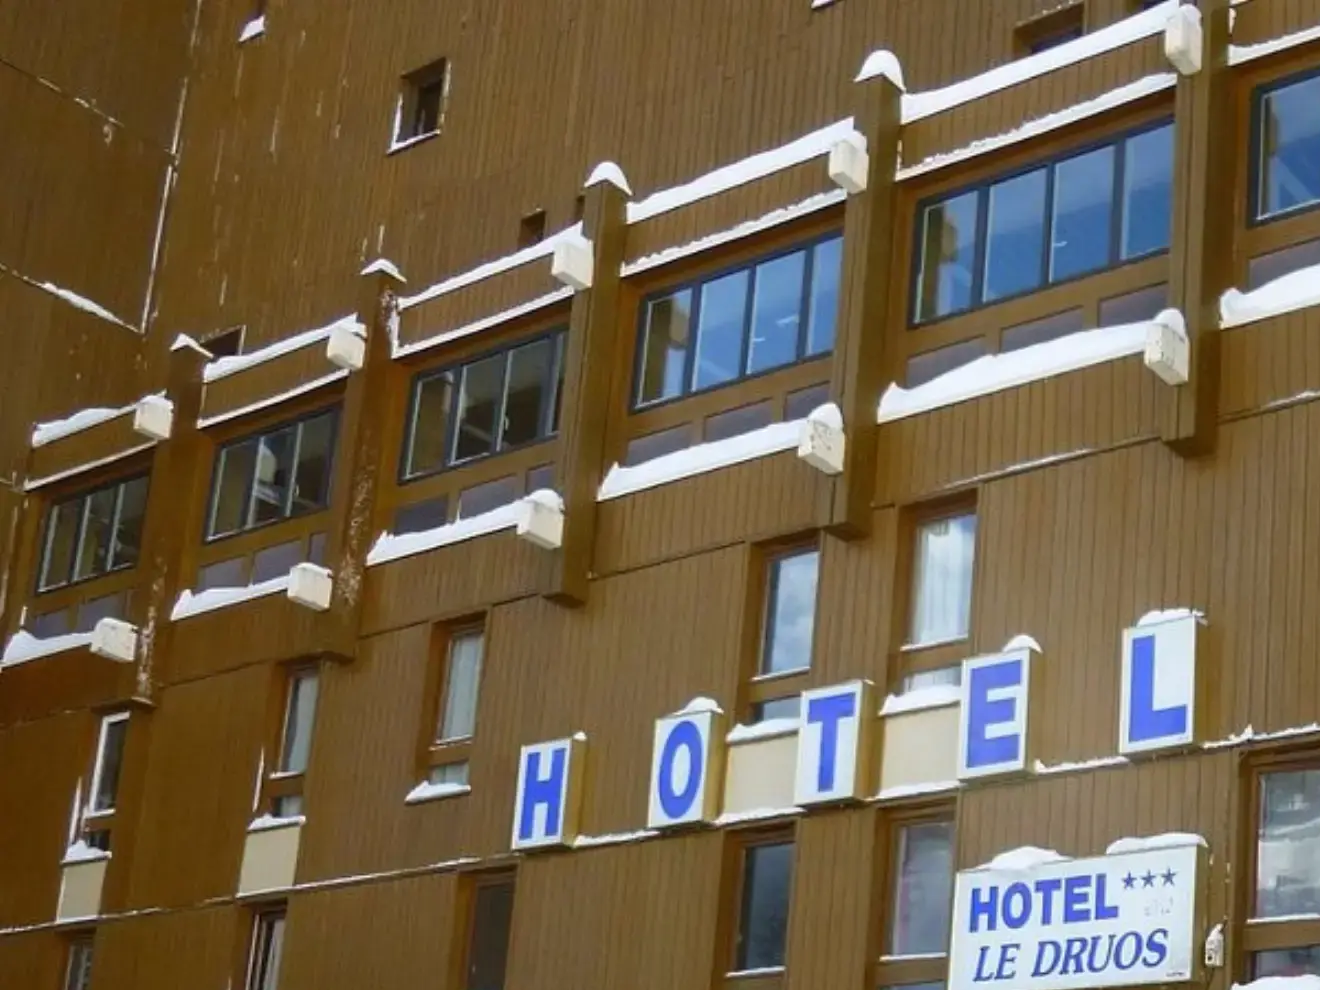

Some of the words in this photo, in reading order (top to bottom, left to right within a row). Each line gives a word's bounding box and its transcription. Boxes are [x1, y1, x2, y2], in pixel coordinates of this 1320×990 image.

[969, 873, 1119, 933] HOTEL
[972, 943, 1021, 982] LE
[1031, 928, 1169, 978] DRUOS
